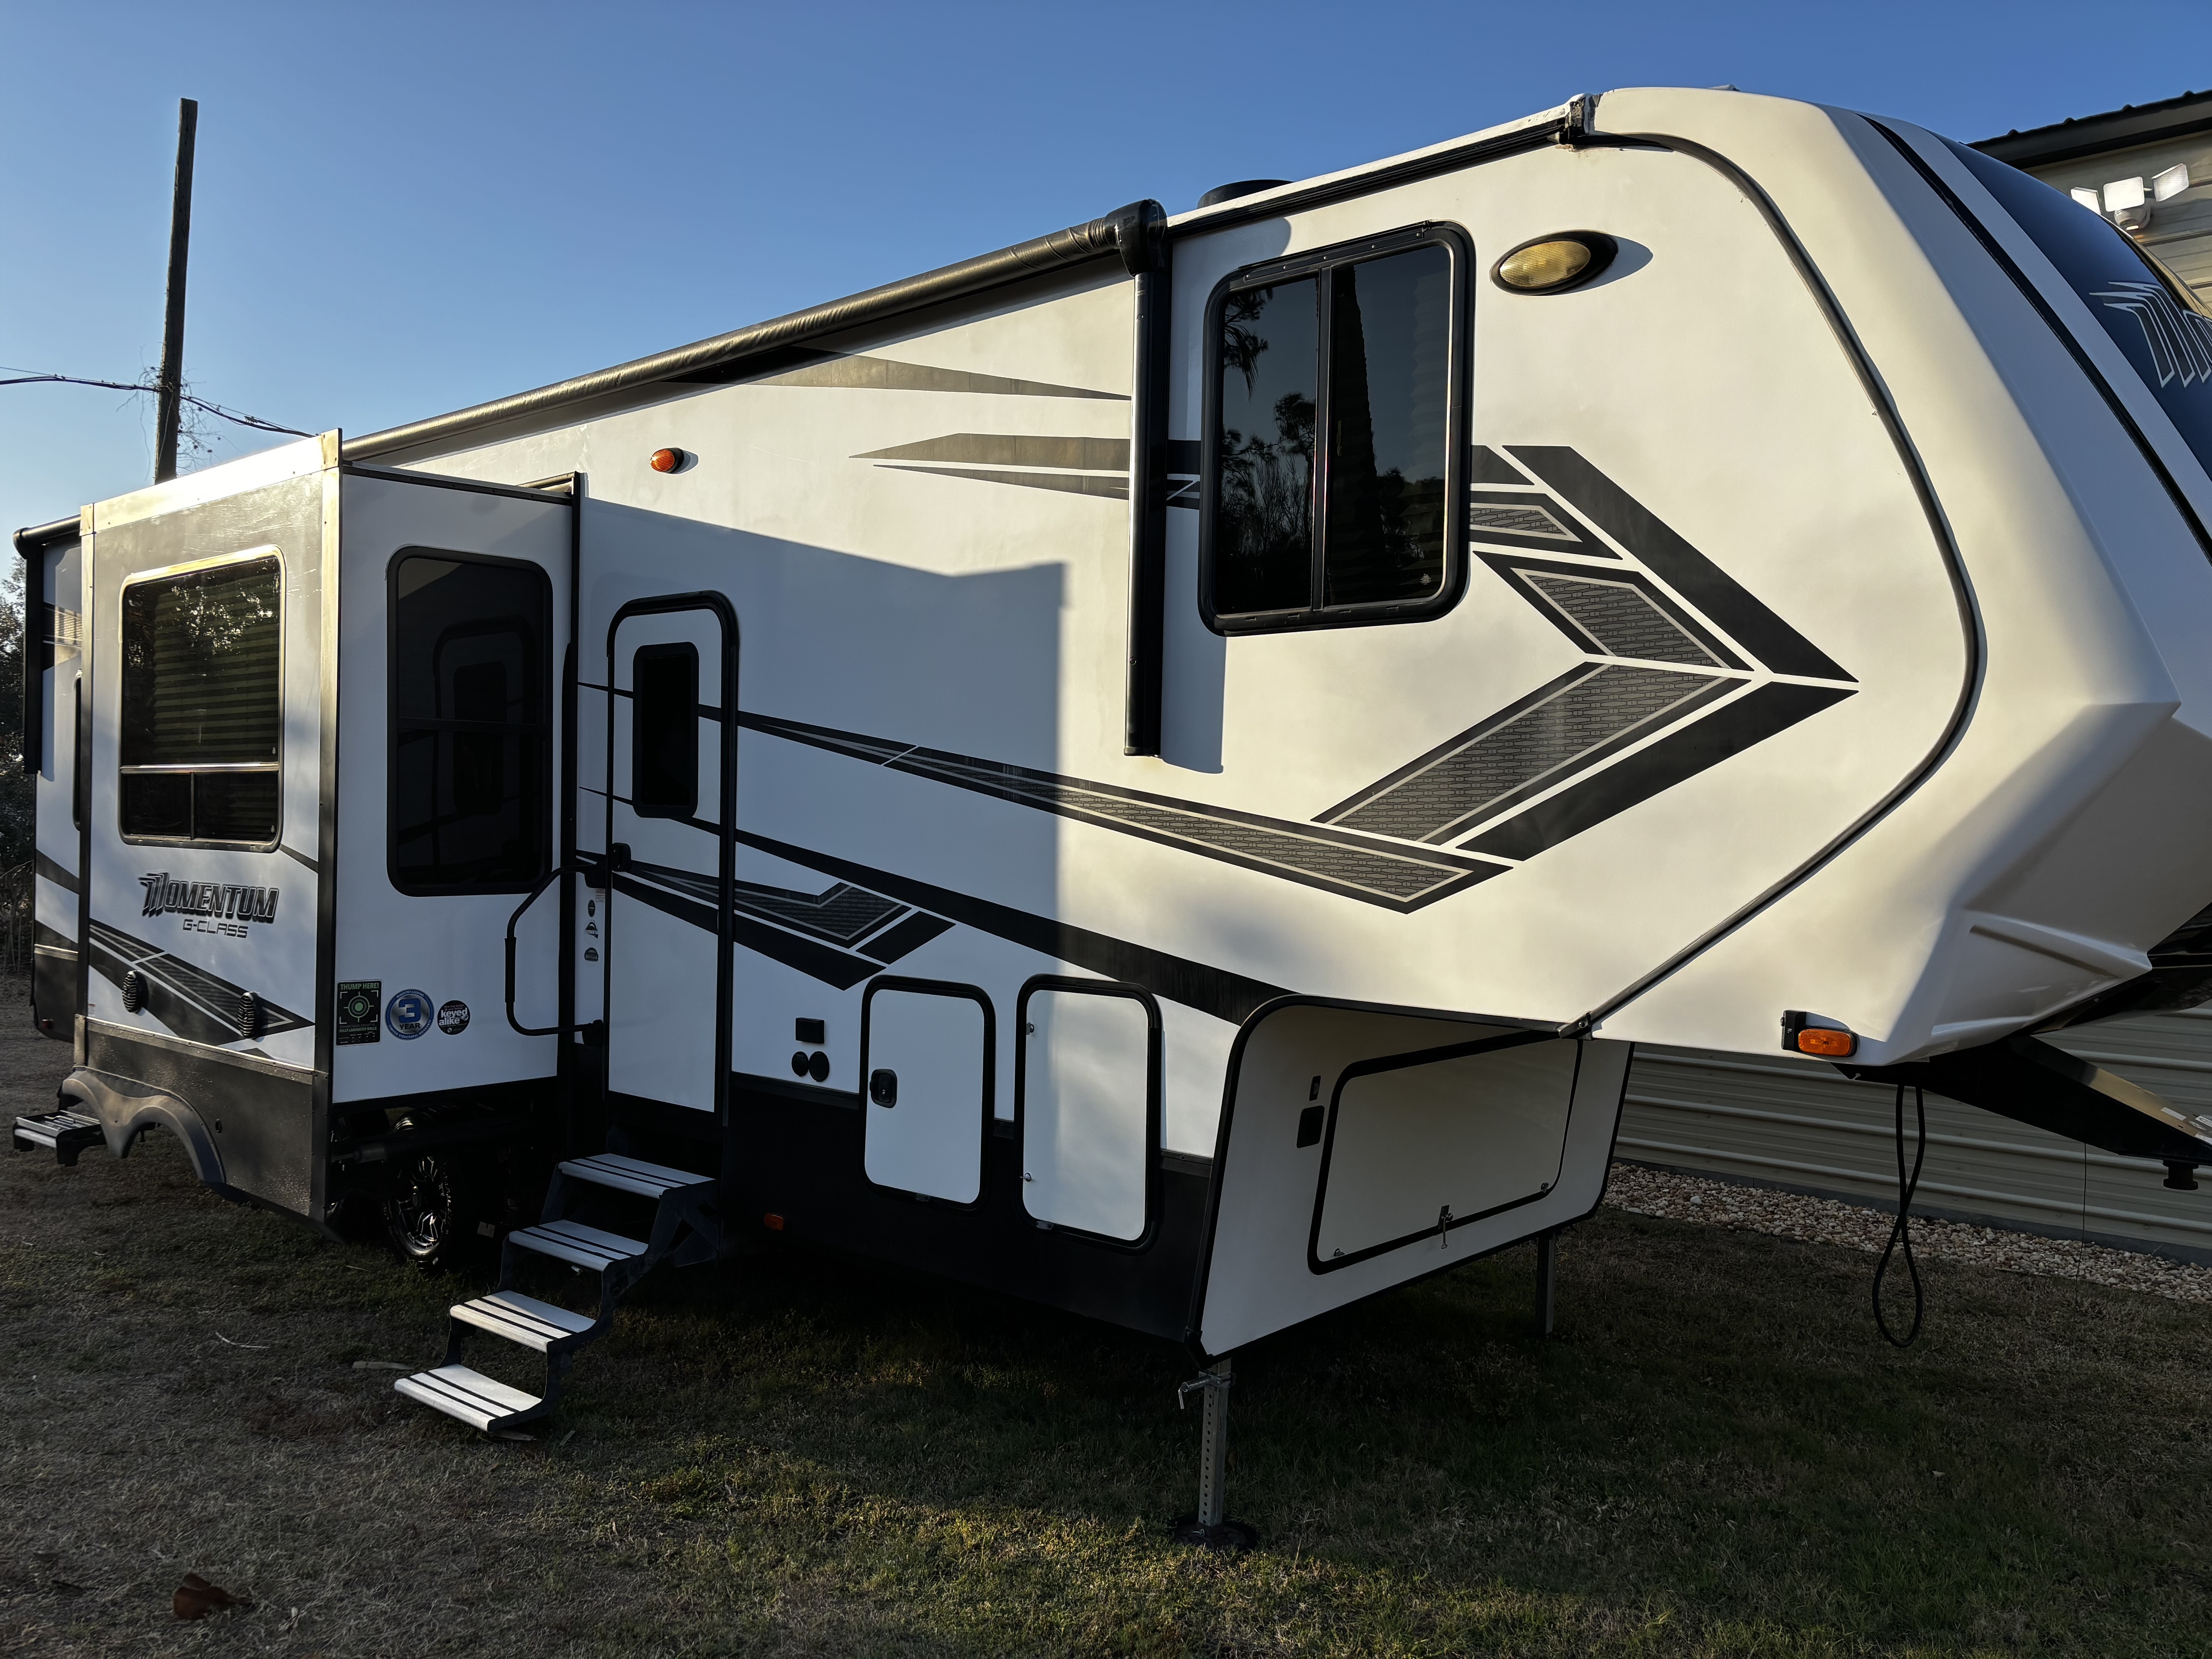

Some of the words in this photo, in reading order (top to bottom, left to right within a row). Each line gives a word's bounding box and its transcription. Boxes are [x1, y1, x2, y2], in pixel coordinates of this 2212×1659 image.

[138, 870, 280, 923] MOMENTUM
[182, 919, 249, 938] G-CLASS
[396, 991, 411, 999] INDUSTRY
[398, 998, 421, 1023] 3
[441, 1007, 467, 1018] keyed
[388, 1024, 399, 1036] LIMITED
[418, 1019, 432, 1036] WARRANTY
[438, 1017, 460, 1026] alike
